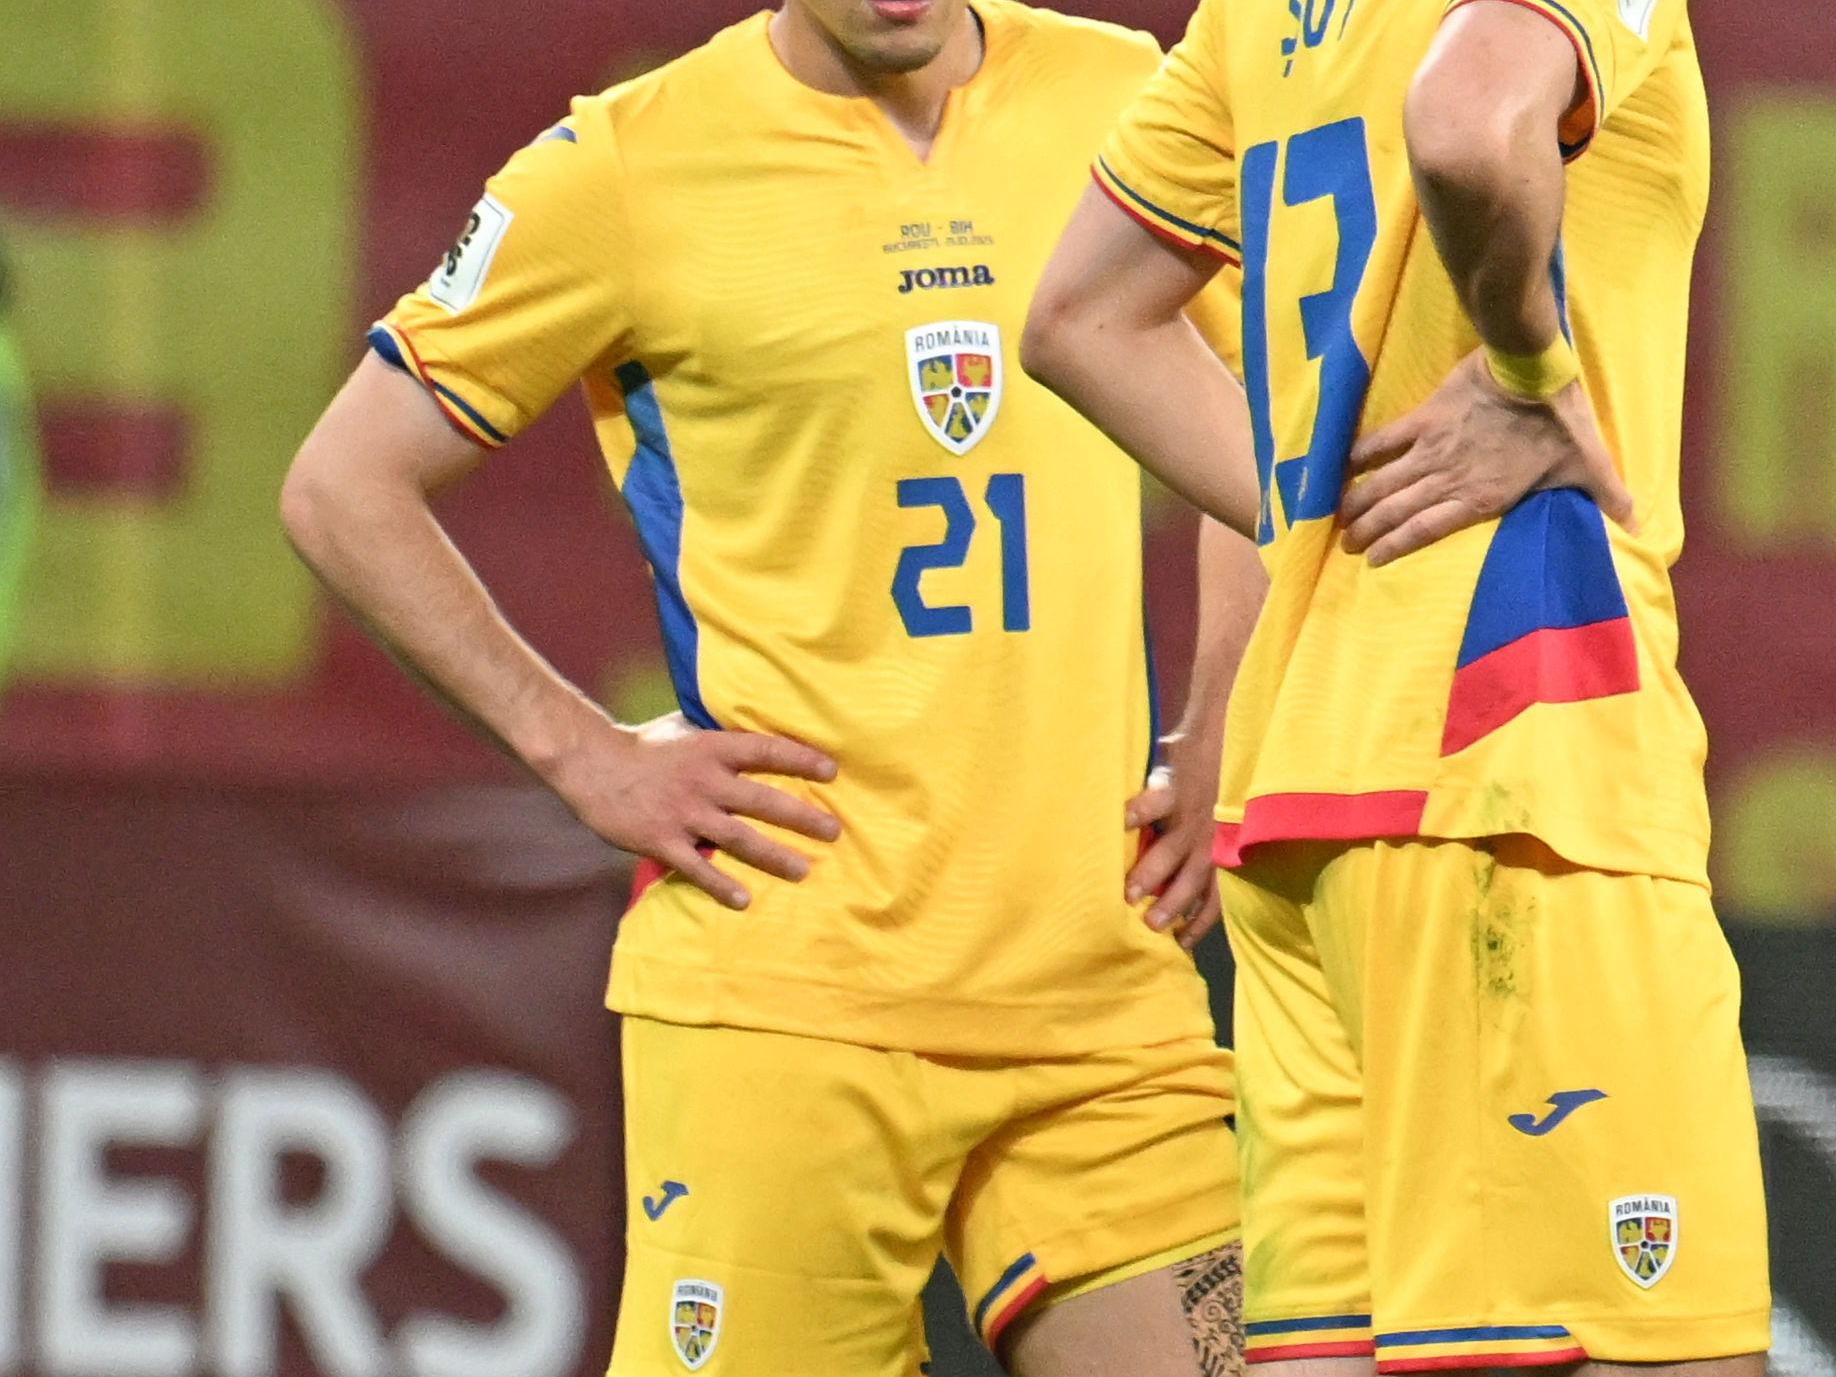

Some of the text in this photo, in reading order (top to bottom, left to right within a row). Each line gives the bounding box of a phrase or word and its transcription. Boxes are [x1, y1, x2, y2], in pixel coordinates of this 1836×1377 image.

[915, 325, 990, 352] ROMÂNIA
[1240, 116, 1378, 546] 13
[890, 473, 1031, 638] 21
